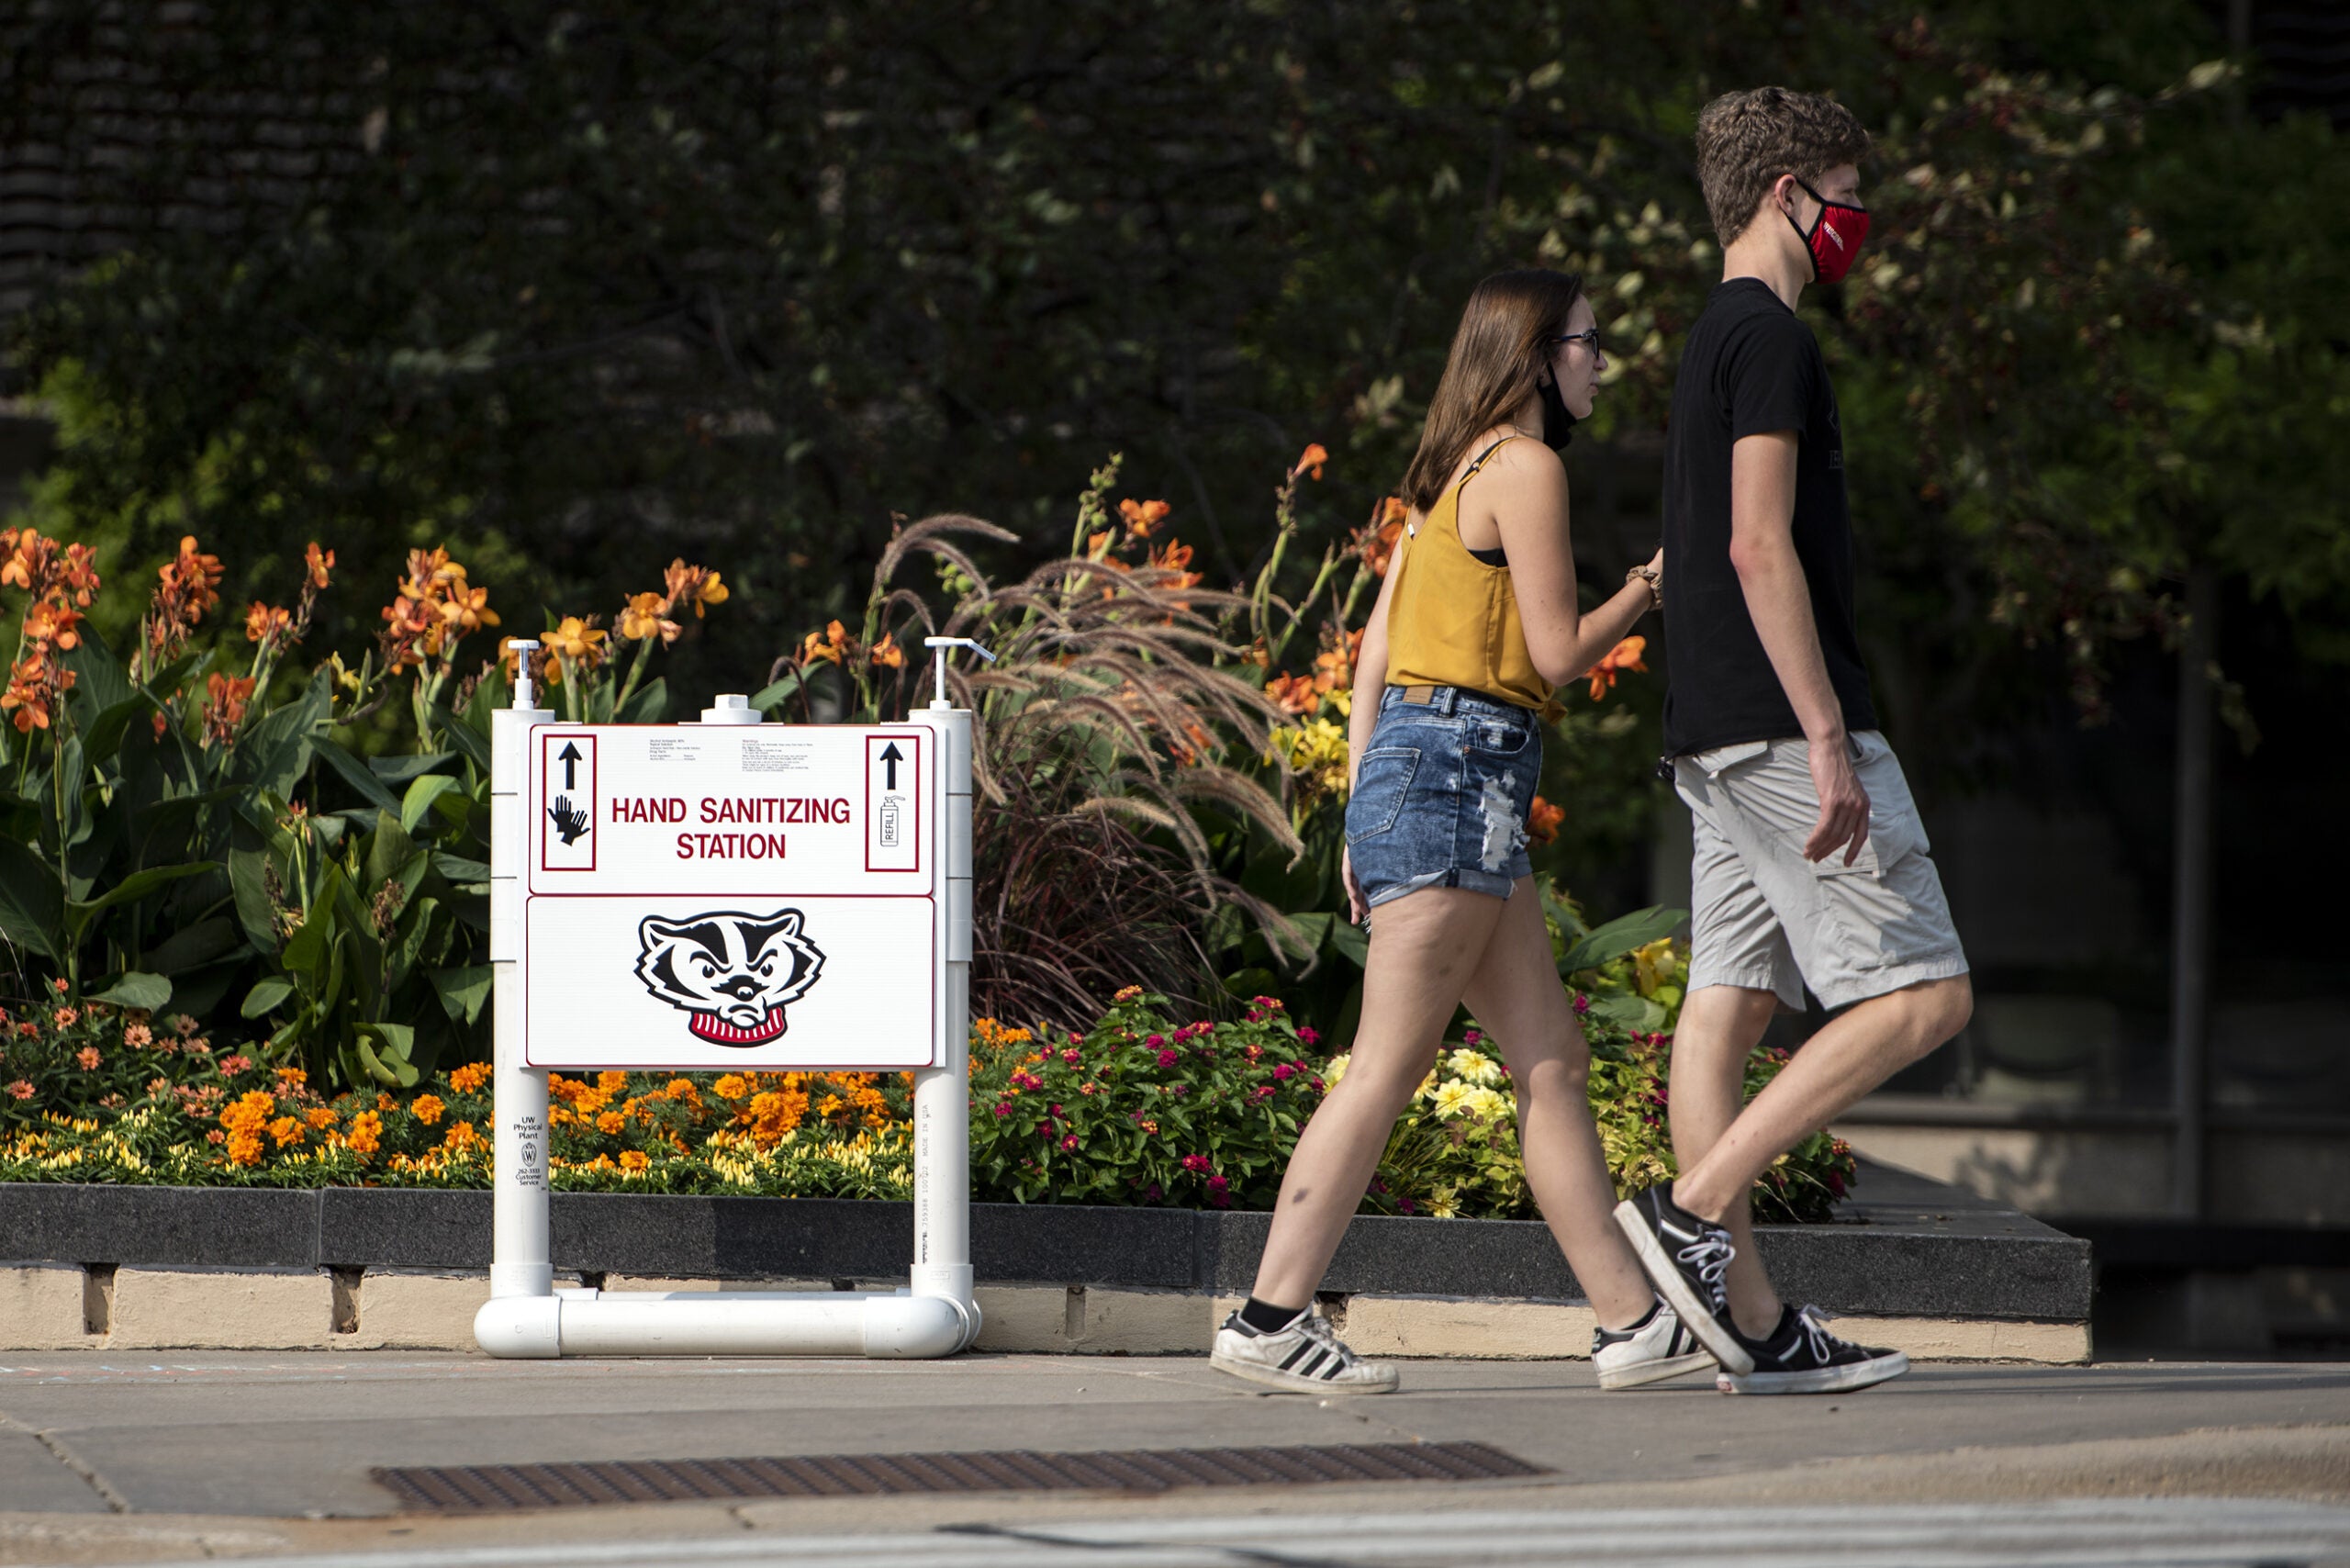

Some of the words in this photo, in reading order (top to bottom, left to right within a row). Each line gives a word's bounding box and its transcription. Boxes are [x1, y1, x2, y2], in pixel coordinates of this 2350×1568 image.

[612, 798, 687, 823] HAND
[699, 797, 851, 823] SANITIZING
[885, 812, 894, 840] REFILL
[677, 833, 786, 859] STATION
[513, 1124, 543, 1132] Physical
[922, 1123, 928, 1132] IN
